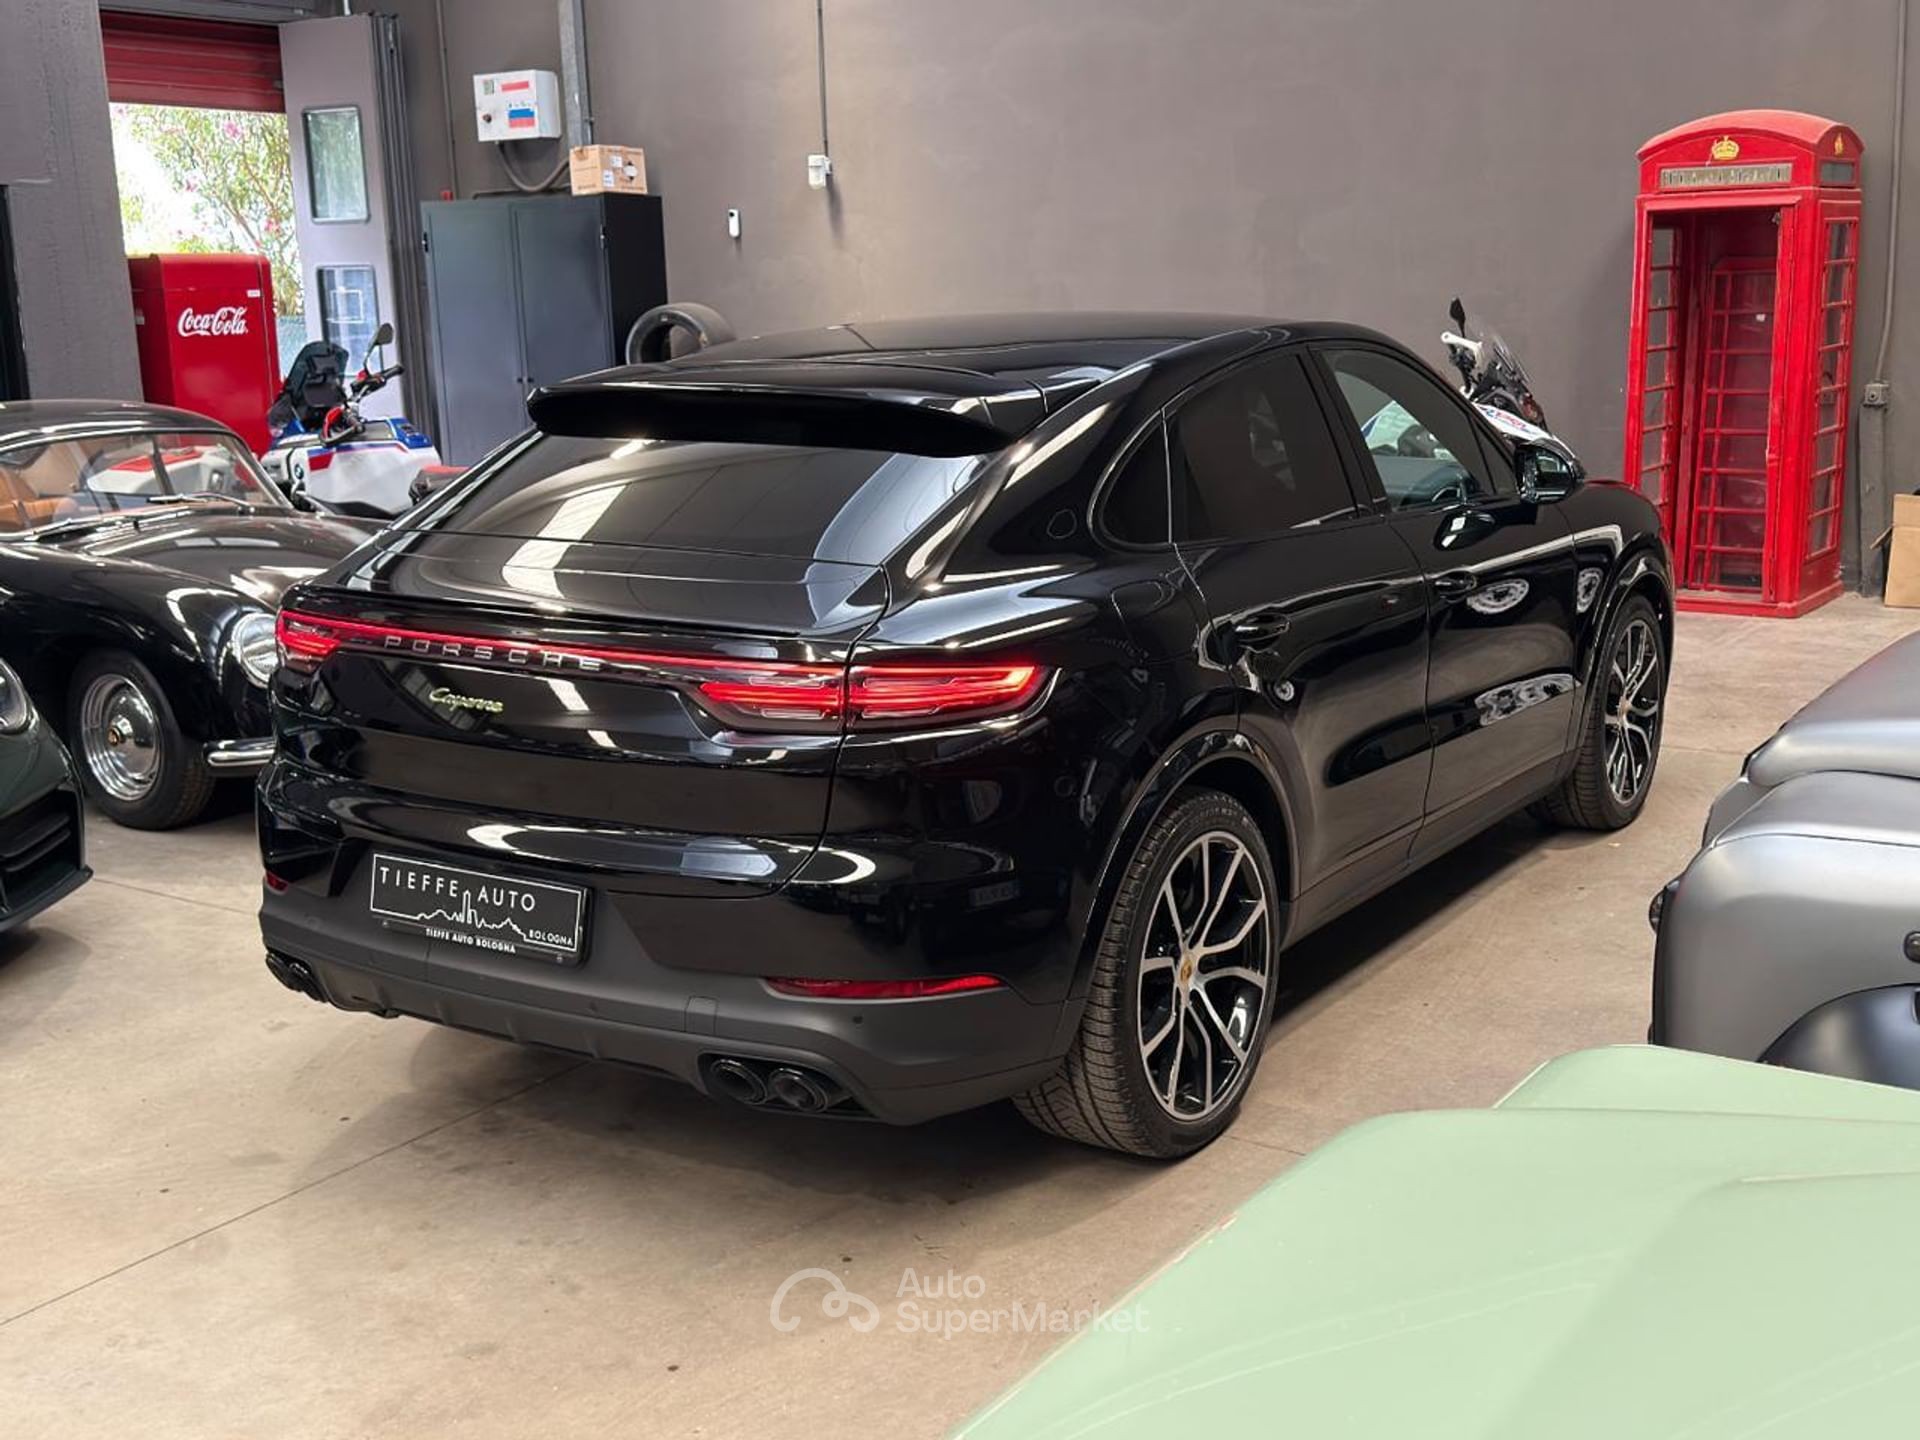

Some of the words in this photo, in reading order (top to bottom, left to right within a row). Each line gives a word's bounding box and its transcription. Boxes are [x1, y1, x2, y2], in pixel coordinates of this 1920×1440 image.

[384, 635, 601, 671] PORSCHE
[429, 687, 503, 713] Cayenne
[379, 866, 459, 897] TIEFFE
[477, 885, 536, 912] AUTO
[426, 928, 450, 941] TIEFFE
[451, 934, 474, 946] AUTO
[475, 937, 516, 954] BOLOGNA
[528, 929, 574, 946] BOLOGNA
